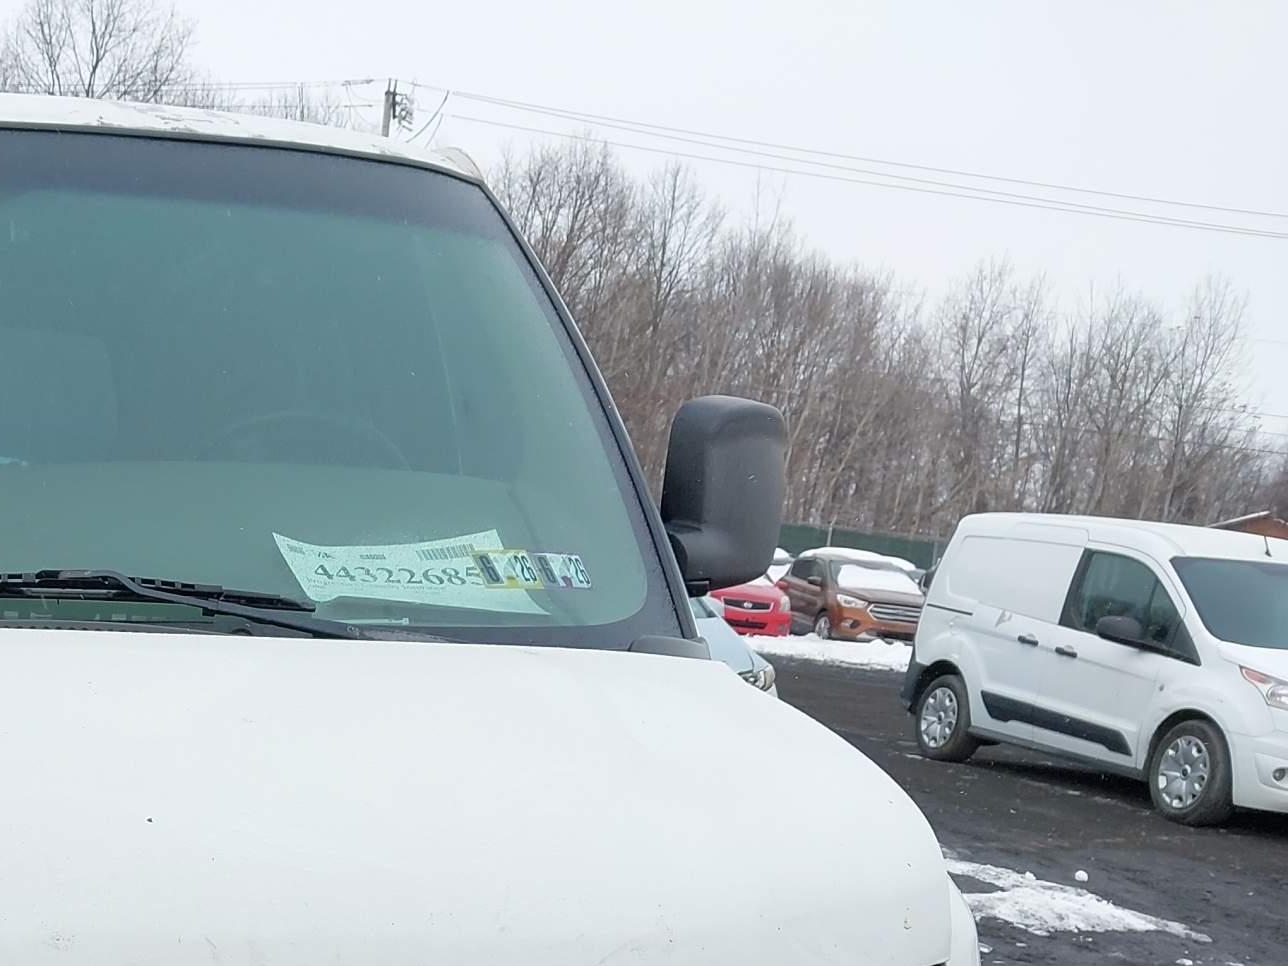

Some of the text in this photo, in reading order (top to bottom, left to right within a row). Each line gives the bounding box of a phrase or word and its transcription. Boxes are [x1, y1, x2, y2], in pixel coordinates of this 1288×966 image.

[314, 565, 483, 585] 44322685
[513, 556, 538, 583] 26
[567, 557, 591, 585] 26
